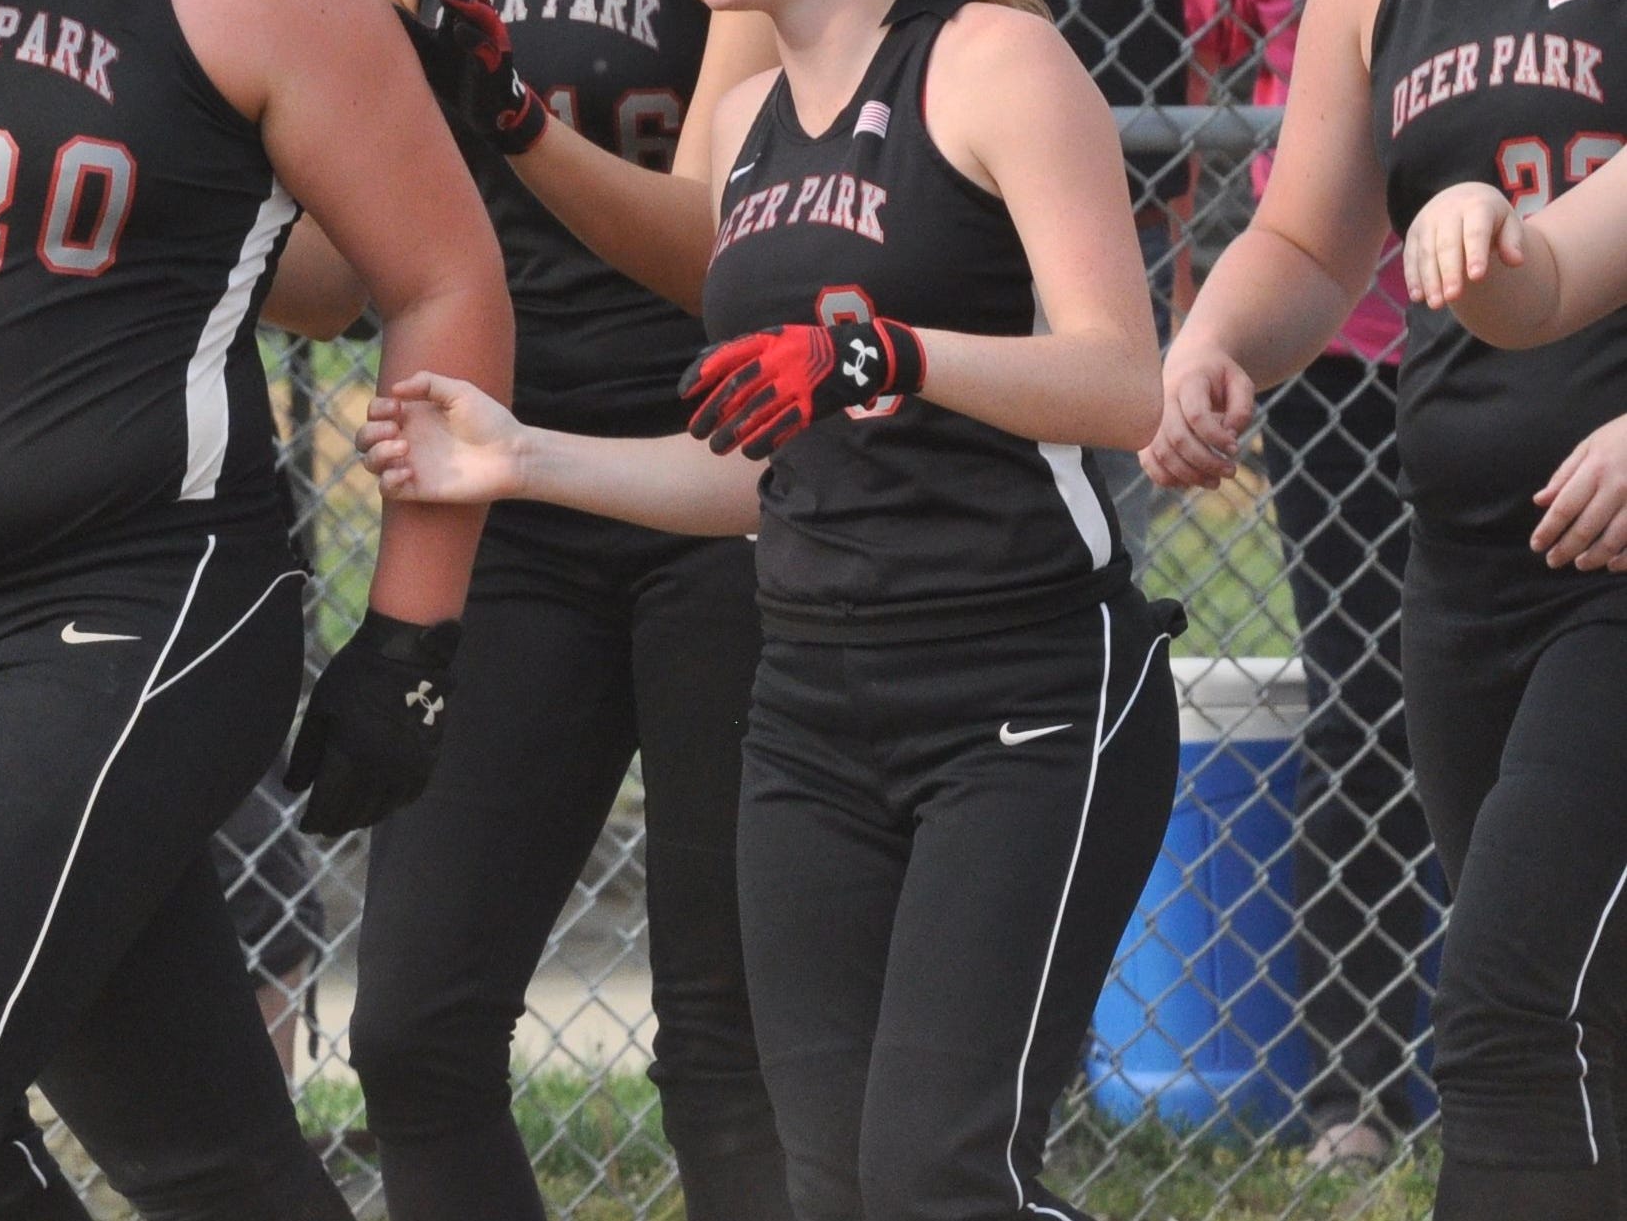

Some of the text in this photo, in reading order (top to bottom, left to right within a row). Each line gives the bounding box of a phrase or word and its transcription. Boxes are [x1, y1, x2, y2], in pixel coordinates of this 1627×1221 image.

[1390, 31, 1606, 140] DEER PARK
[786, 172, 888, 246] PARK
